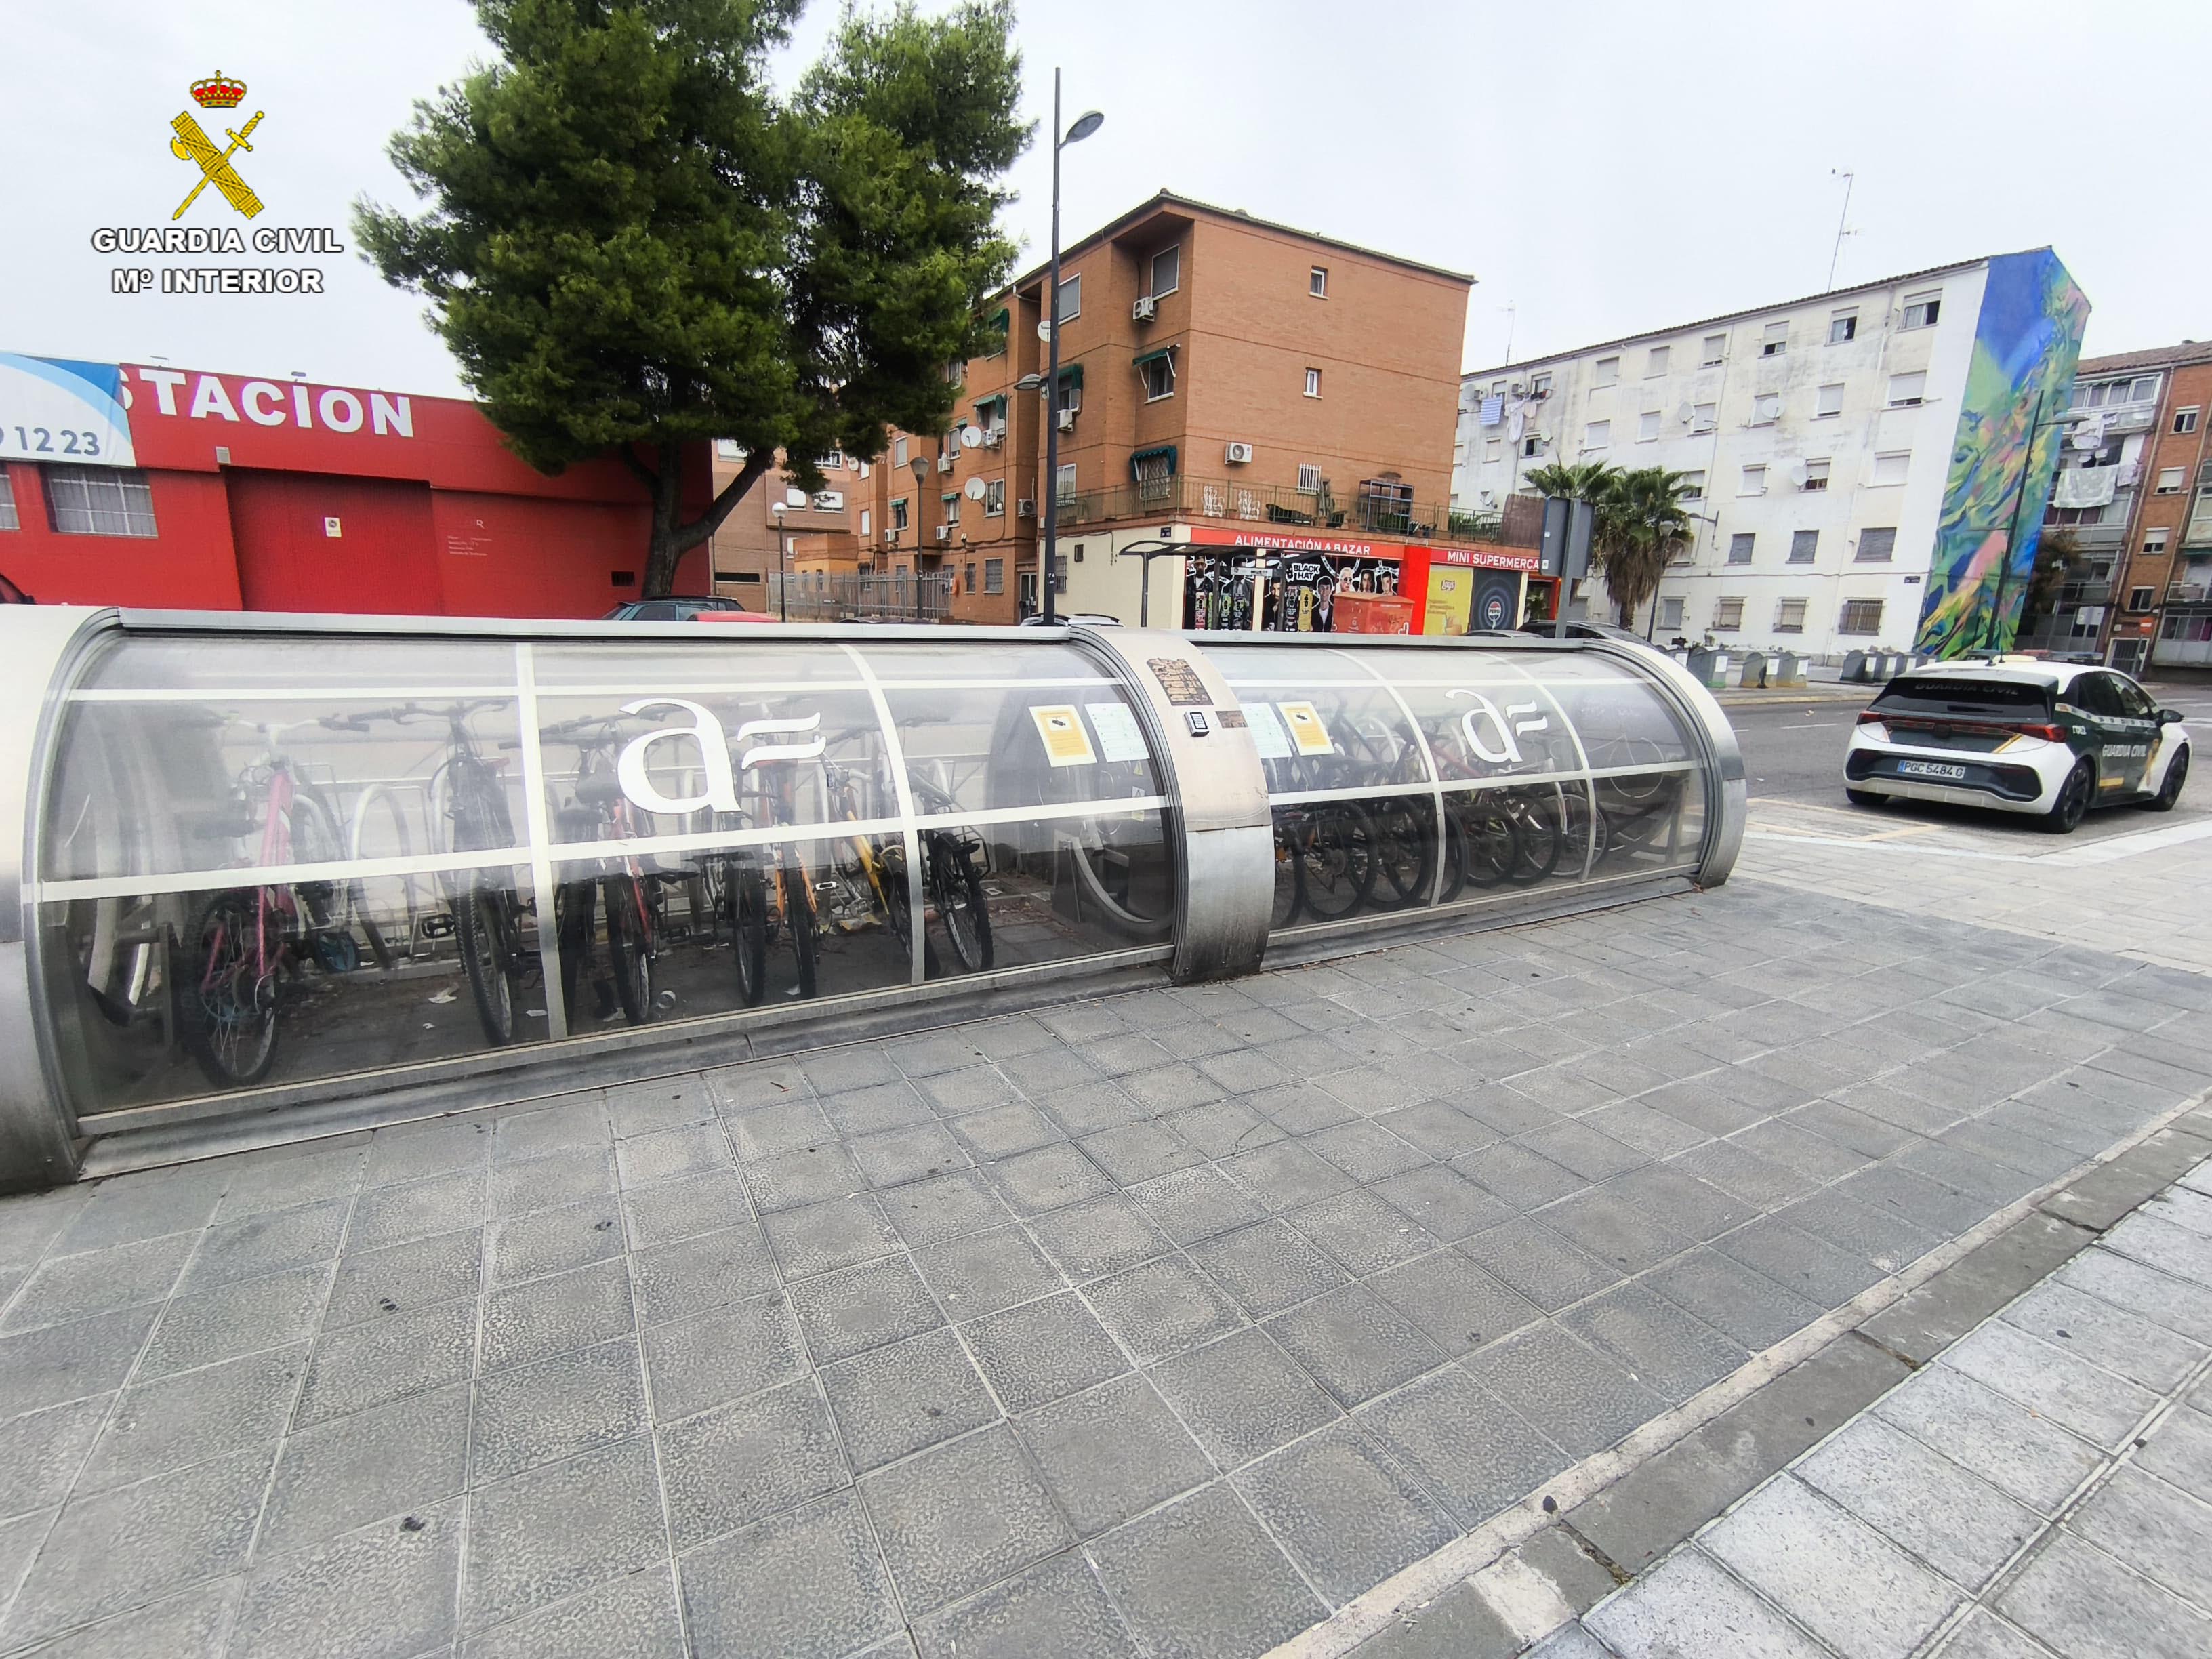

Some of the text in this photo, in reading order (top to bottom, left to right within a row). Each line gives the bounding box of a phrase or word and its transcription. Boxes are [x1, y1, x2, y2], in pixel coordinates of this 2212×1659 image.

[1334, 543, 1370, 555] BAZAR
[1447, 551, 1470, 563] MINI
[1292, 564, 1320, 574] BLACK
[1904, 762, 1964, 777] PGC 5484 G
